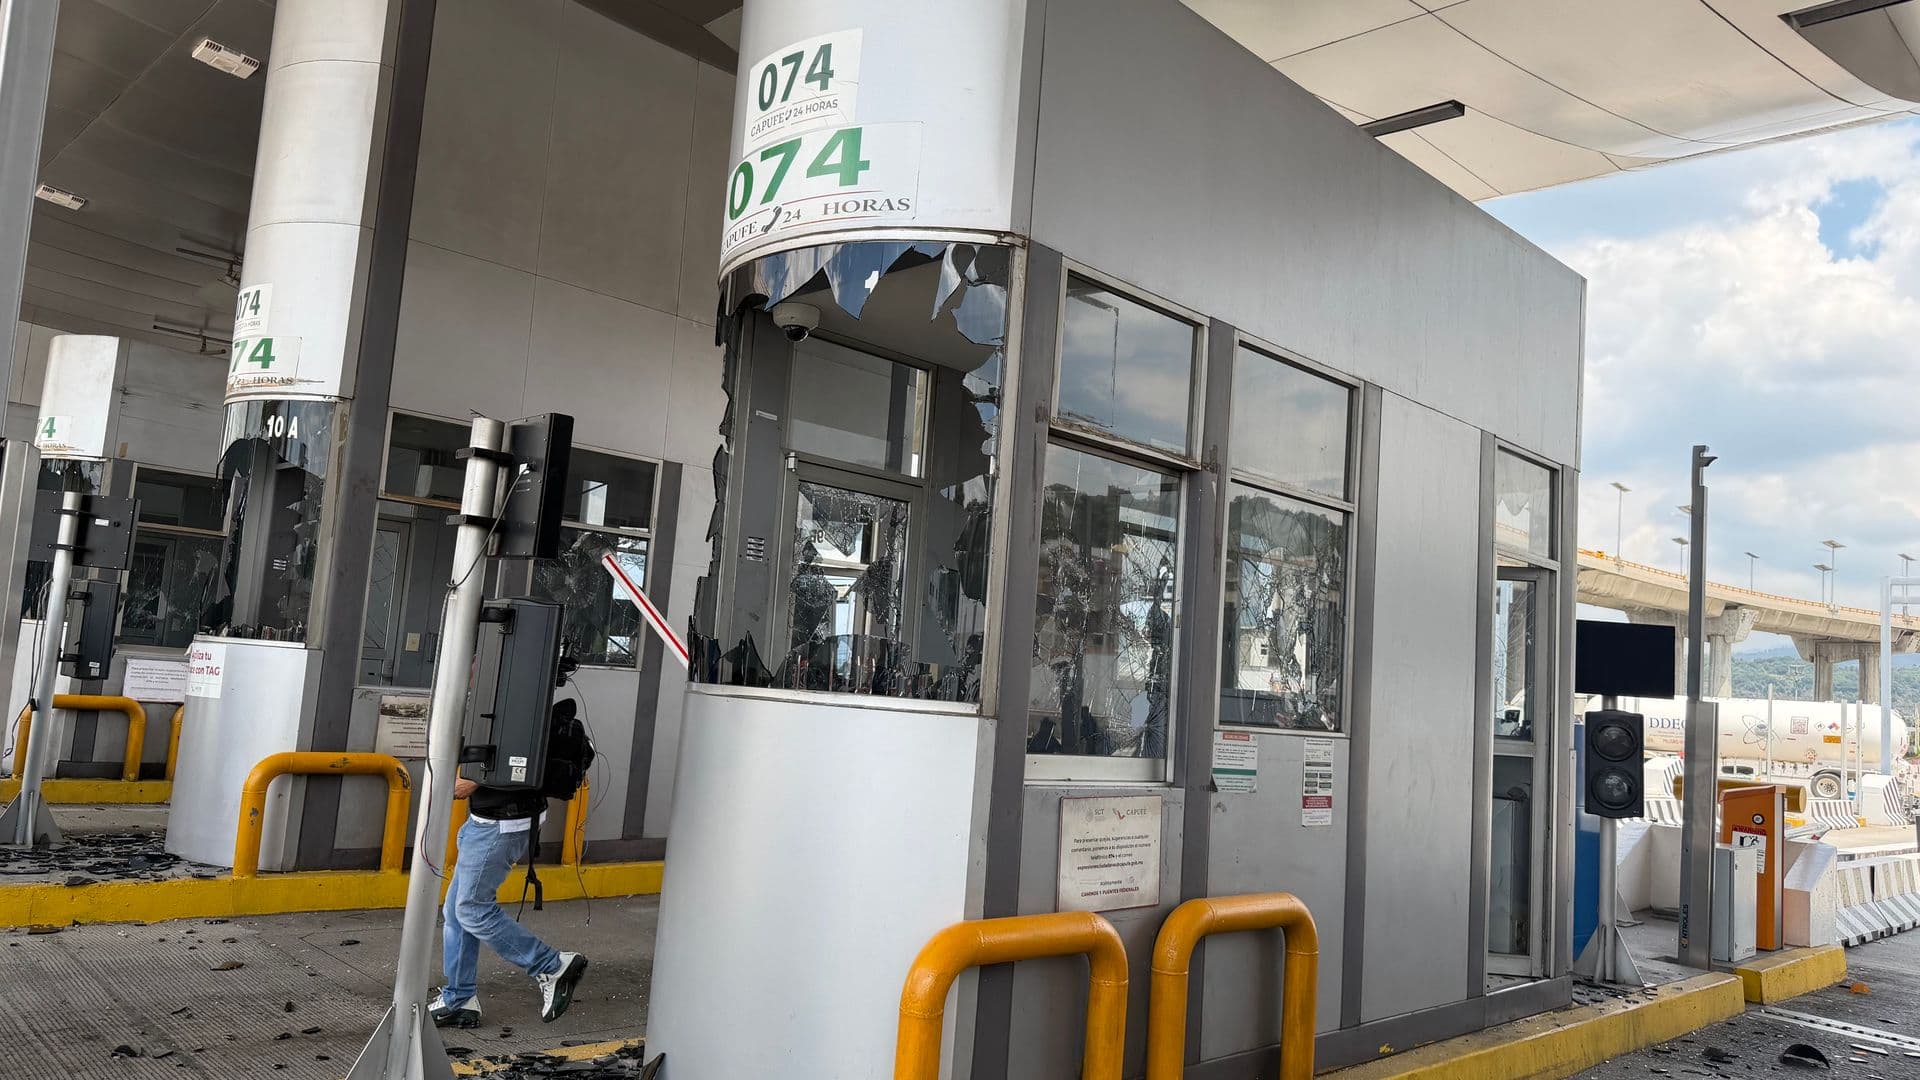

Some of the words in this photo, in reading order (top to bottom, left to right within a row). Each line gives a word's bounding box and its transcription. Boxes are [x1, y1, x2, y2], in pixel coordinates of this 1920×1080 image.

[758, 43, 834, 111] 074
[751, 112, 785, 137] CAPUFE
[793, 108, 803, 117] 24
[805, 99, 838, 114] HORAS
[729, 127, 870, 220] 074
[784, 209, 801, 223] 24
[823, 198, 910, 215] HORAS
[253, 377, 293, 385] HORAS
[38, 417, 56, 438] 4
[267, 415, 284, 438] 10
[287, 416, 298, 439] A
[205, 665, 220, 676] TAG
